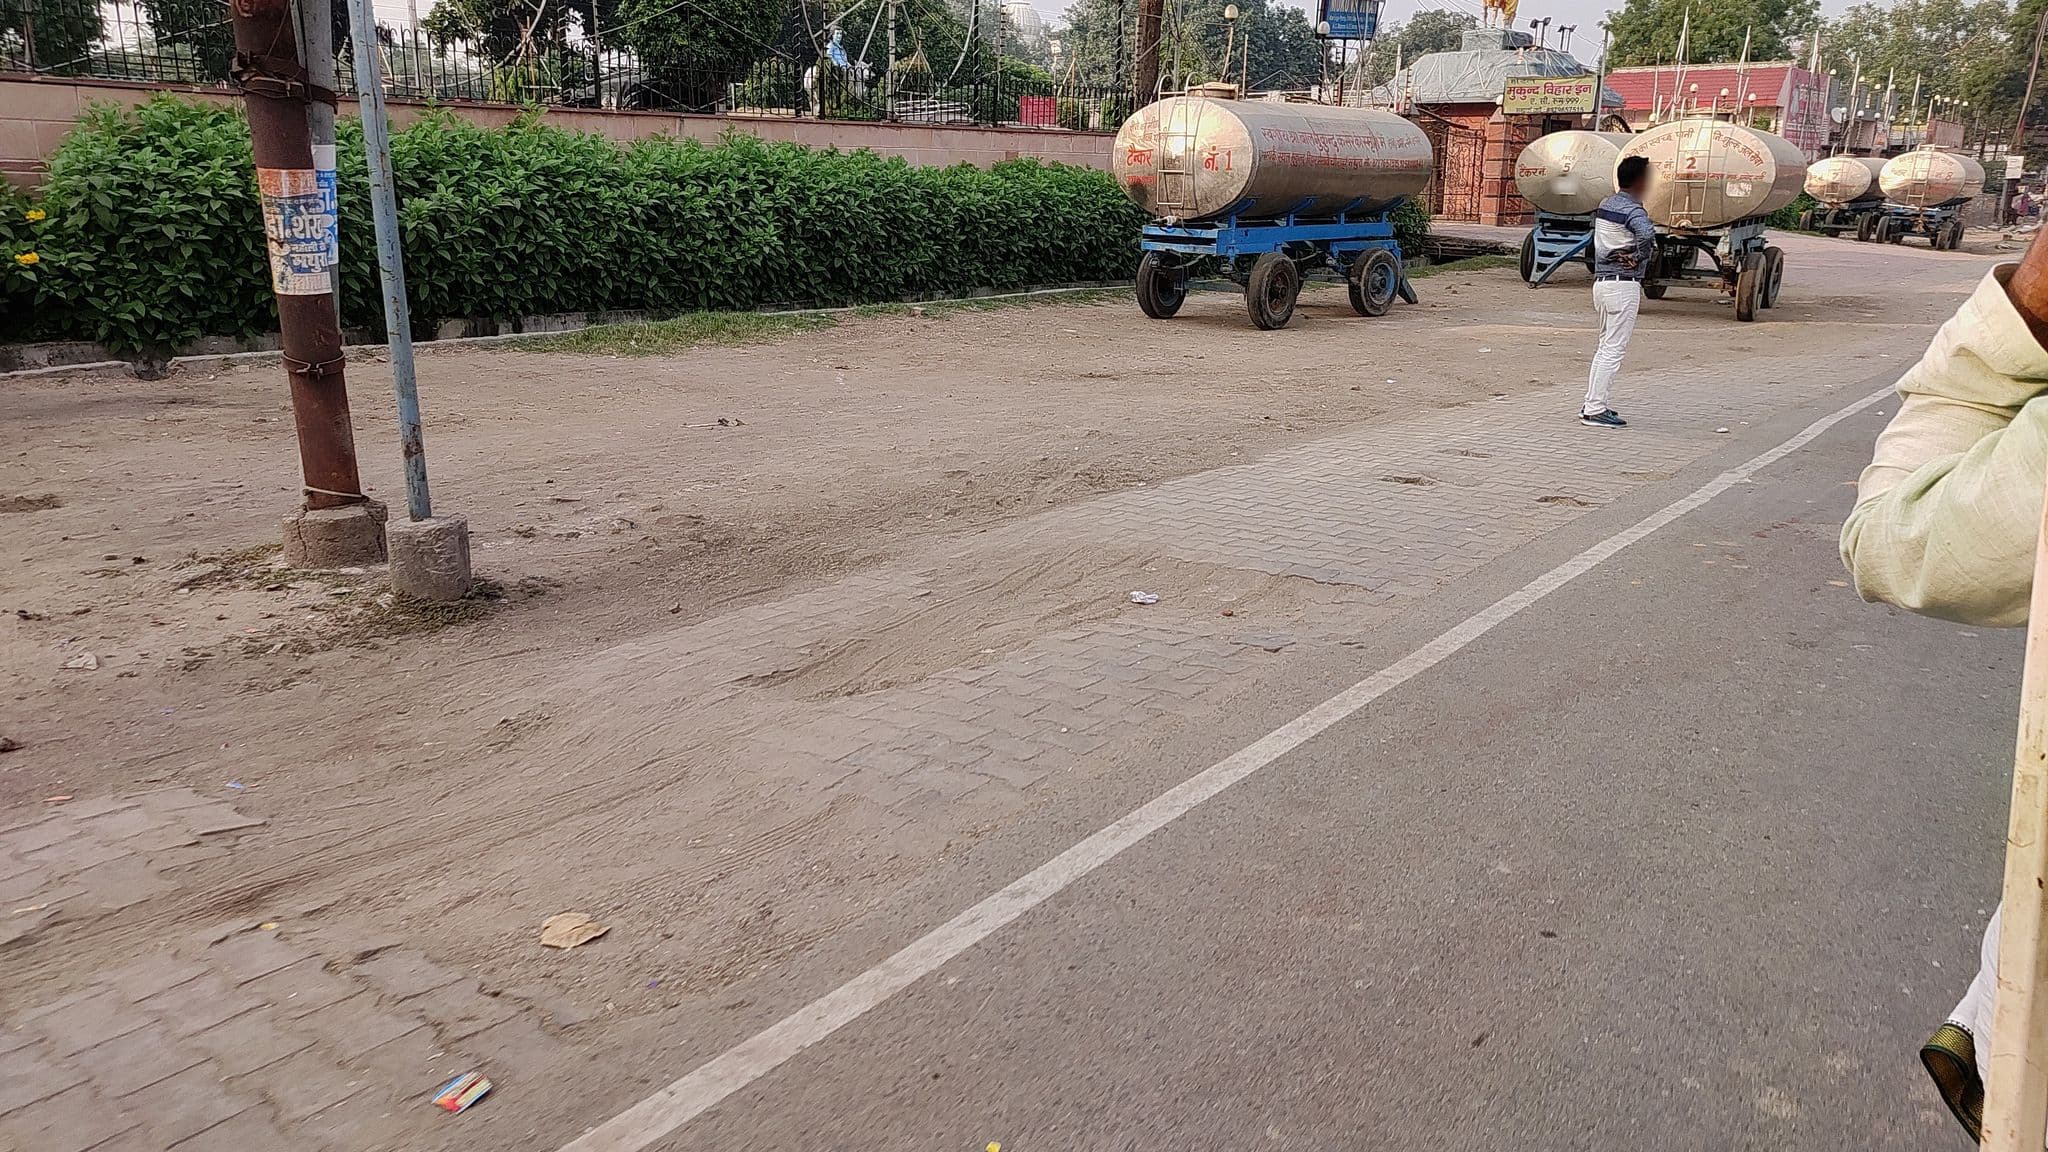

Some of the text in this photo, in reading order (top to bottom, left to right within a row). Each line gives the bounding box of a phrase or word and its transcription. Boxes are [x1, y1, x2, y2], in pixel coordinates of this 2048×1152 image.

[1507, 82, 1592, 101] मुकुन्द विहार इन
[1204, 145, 1219, 171] नं.
[1225, 150, 1233, 171] 1
[1686, 156, 1697, 170] 2
[1562, 162, 1571, 173] 5
[1945, 171, 1954, 181] 8
